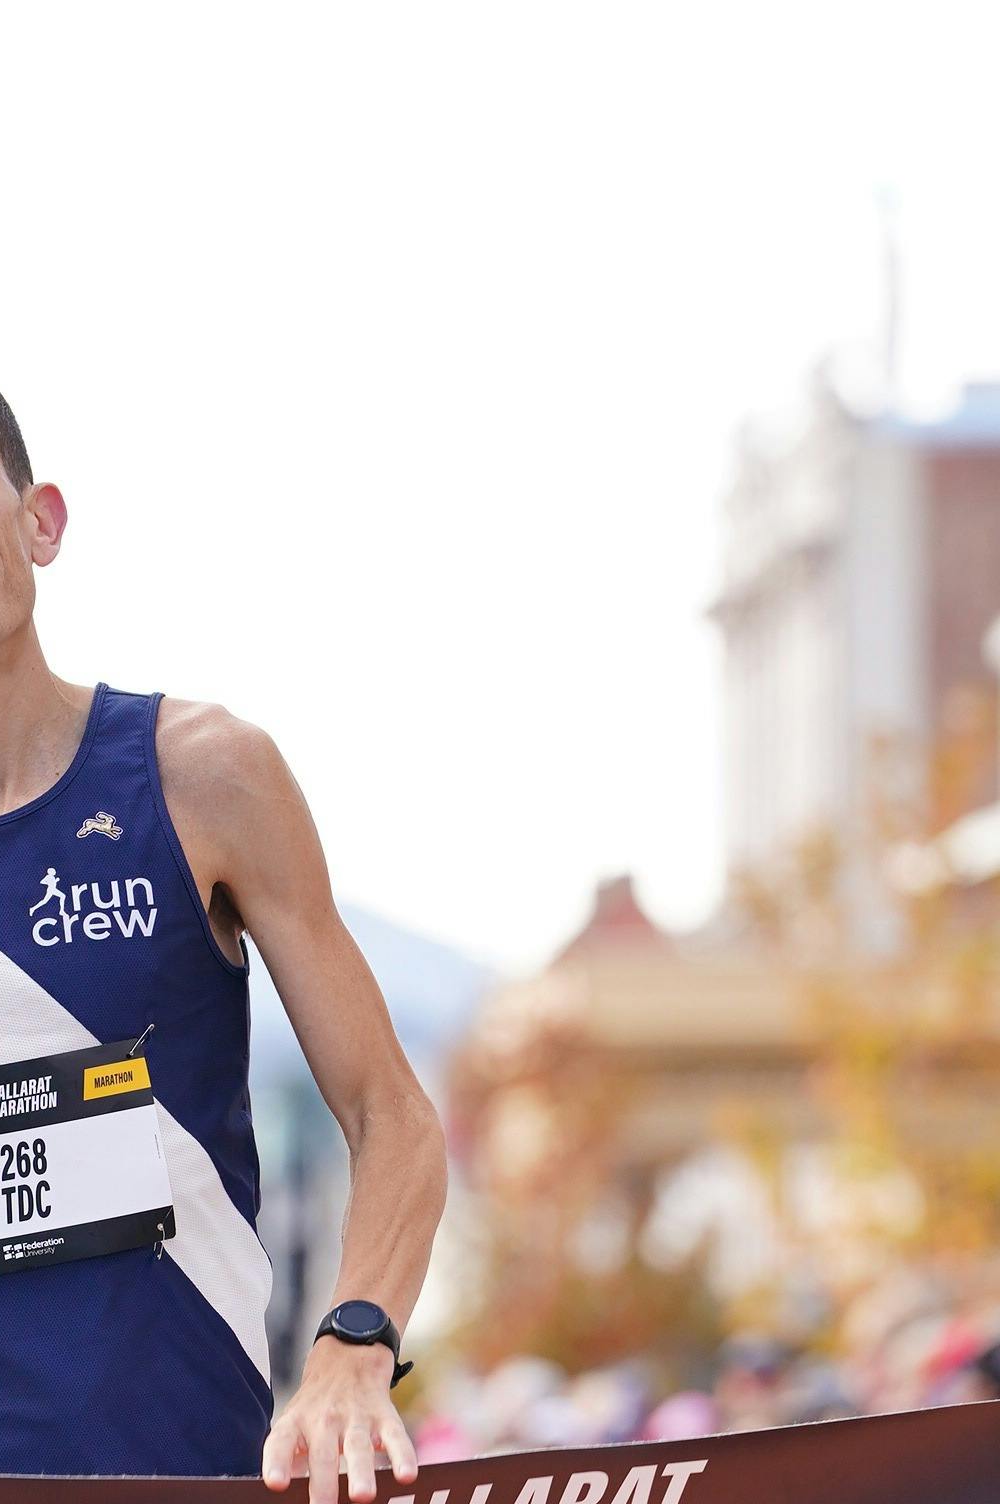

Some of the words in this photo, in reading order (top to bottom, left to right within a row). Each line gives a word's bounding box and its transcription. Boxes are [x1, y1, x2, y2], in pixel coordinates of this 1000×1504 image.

[71, 877, 155, 911] run
[32, 908, 157, 947] crew
[94, 1070, 134, 1089] MARATHON
[1, 1180, 52, 1225] TDC
[22, 1237, 65, 1251] Federation
[23, 1246, 56, 1258] University
